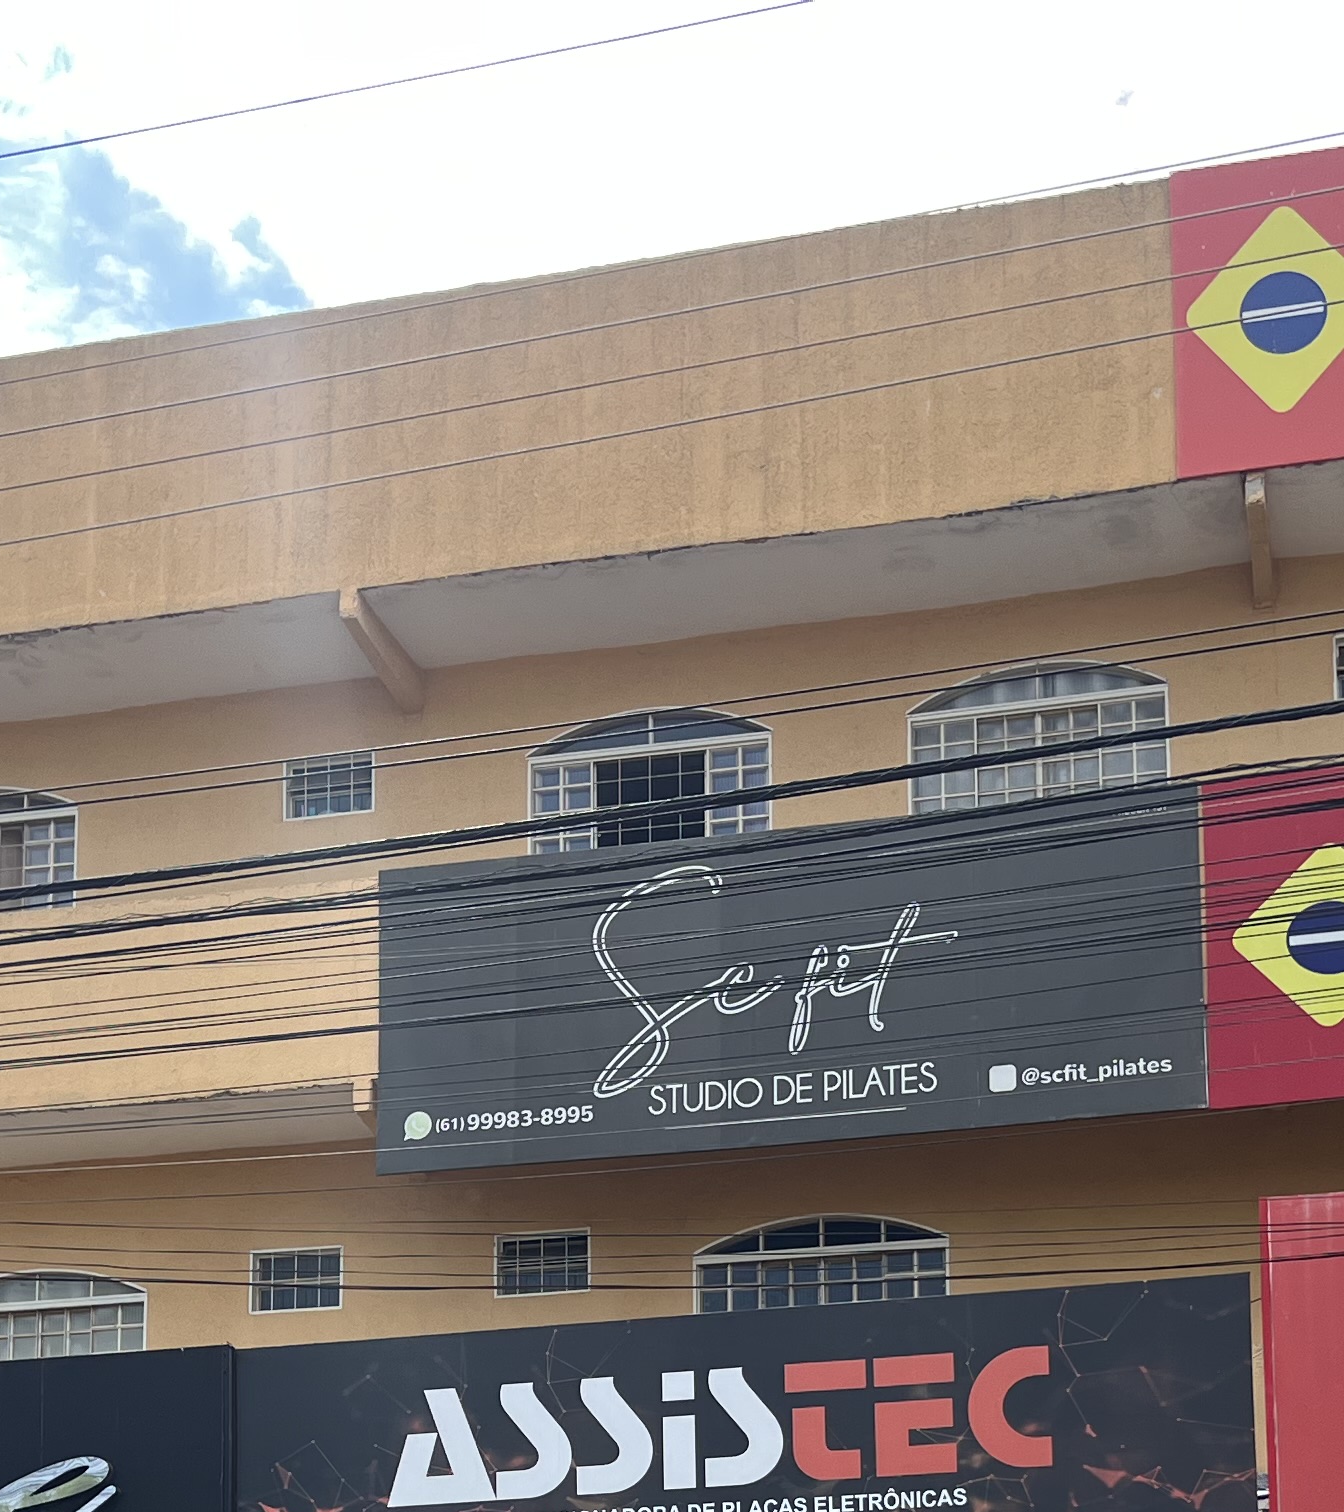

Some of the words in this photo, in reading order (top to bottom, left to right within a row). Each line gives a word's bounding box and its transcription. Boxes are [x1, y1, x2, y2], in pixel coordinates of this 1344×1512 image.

[1020, 1055, 1174, 1088] @scfit_pilates
[648, 1079, 765, 1116] STUDIO
[772, 1075, 814, 1105] DE
[822, 1062, 939, 1100] PILATES
[434, 1114, 466, 1133] (61)
[467, 1104, 595, 1132] 99983-8995
